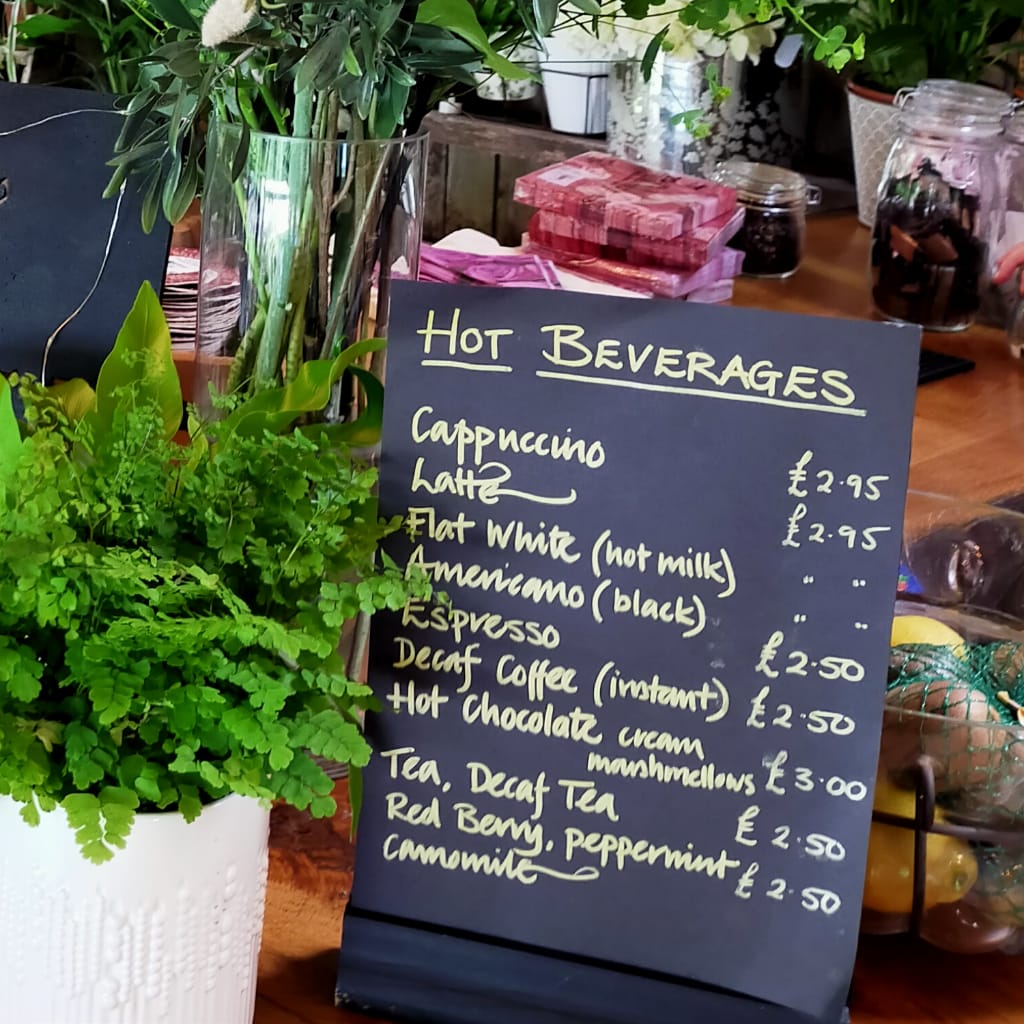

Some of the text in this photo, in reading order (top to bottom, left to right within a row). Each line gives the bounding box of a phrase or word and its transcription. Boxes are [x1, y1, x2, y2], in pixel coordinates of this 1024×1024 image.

[417, 308, 857, 407] HOT BEVERAGES
[411, 406, 606, 468] Cappuccino
[411, 457, 576, 505] Latte
[407, 507, 476, 544] Flat
[487, 519, 581, 564] White
[591, 529, 652, 577] (hot
[657, 547, 736, 598] milk)
[404, 544, 584, 609] Americano
[592, 579, 706, 638] (black)
[402, 597, 561, 649] Espresso
[392, 637, 482, 693] Decaf
[496, 654, 578, 702] Coffee
[593, 661, 729, 723] (instant)
[386, 680, 705, 760] Hot Chocolate cream
[466, 761, 550, 820] Decaf
[558, 779, 619, 821] Tea
[587, 752, 756, 796] marshmellows
[385, 791, 441, 828] Red
